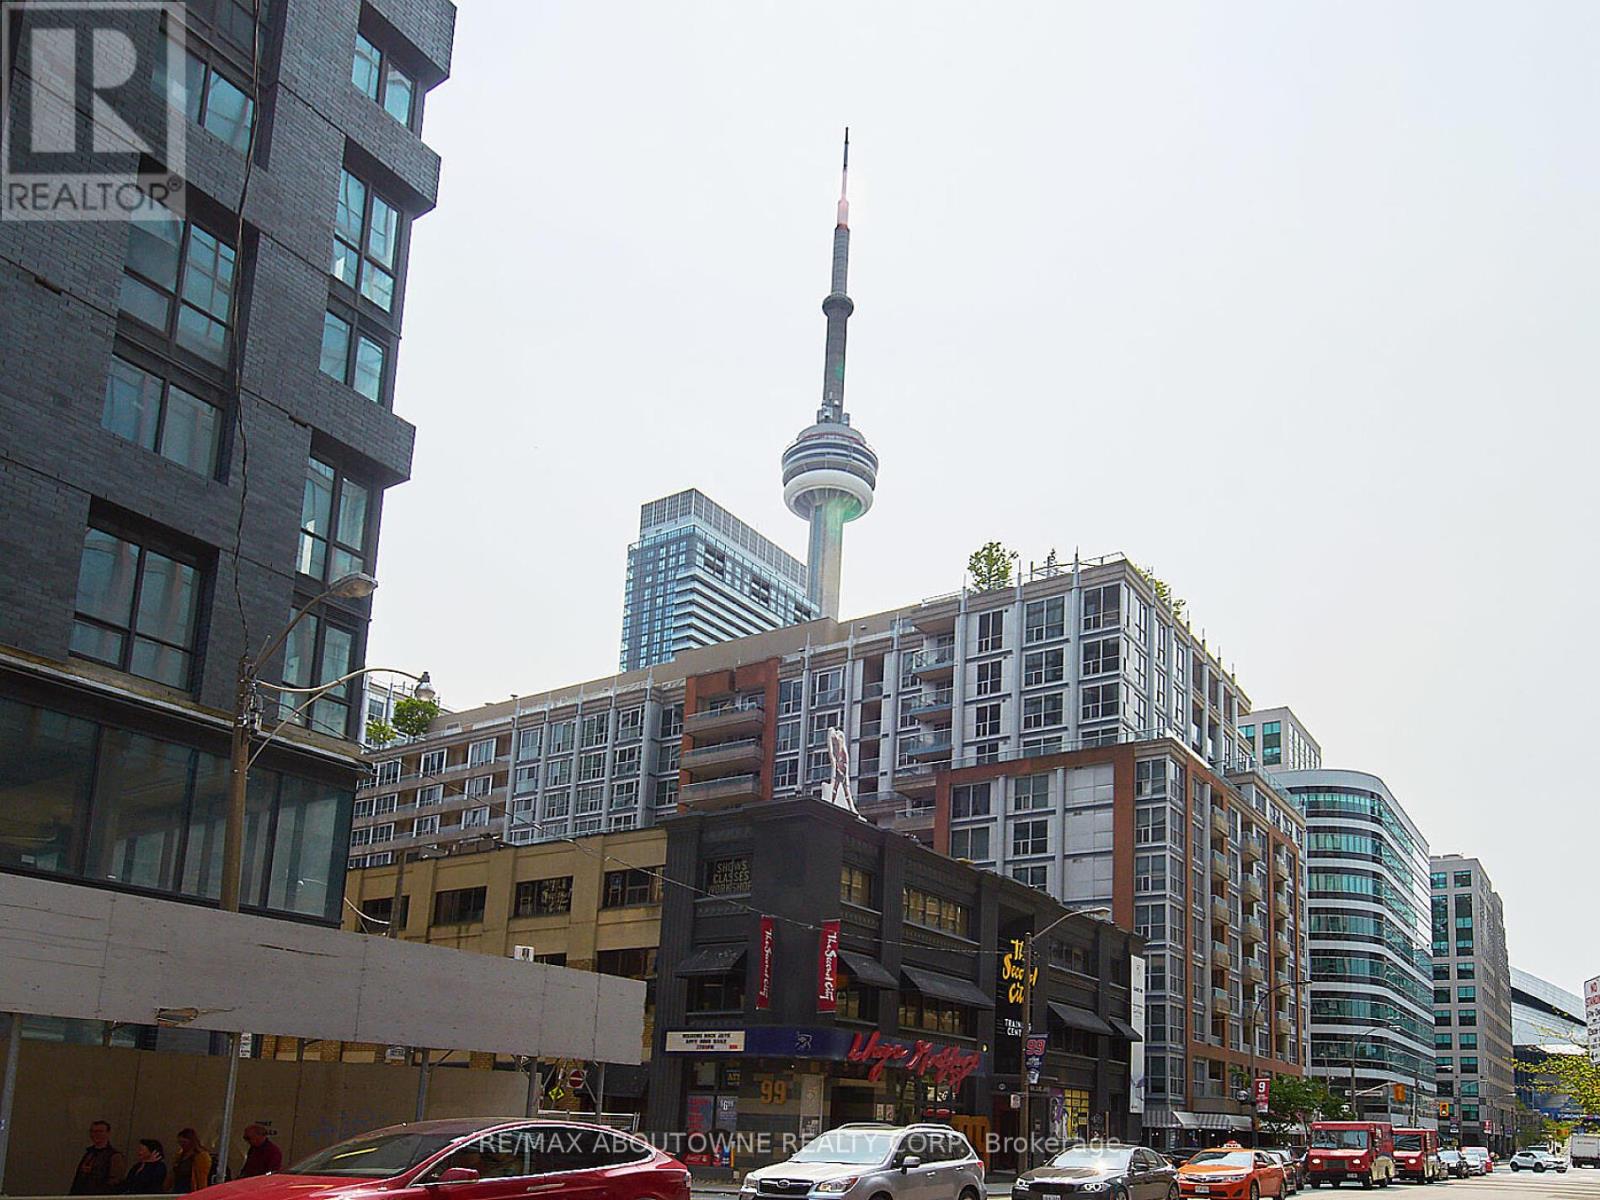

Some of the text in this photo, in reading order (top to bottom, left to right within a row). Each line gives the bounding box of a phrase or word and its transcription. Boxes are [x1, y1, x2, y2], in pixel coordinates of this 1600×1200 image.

[716, 860, 747, 873] SHOWS
[713, 871, 750, 884] CLASSES
[1010, 939, 1025, 961] Th
[819, 932, 838, 1001] The Second City
[1002, 953, 1038, 987] Secod
[1006, 1027, 1023, 1038] CENT
[1025, 1039, 1046, 1056] 99
[760, 1079, 787, 1105] 99
